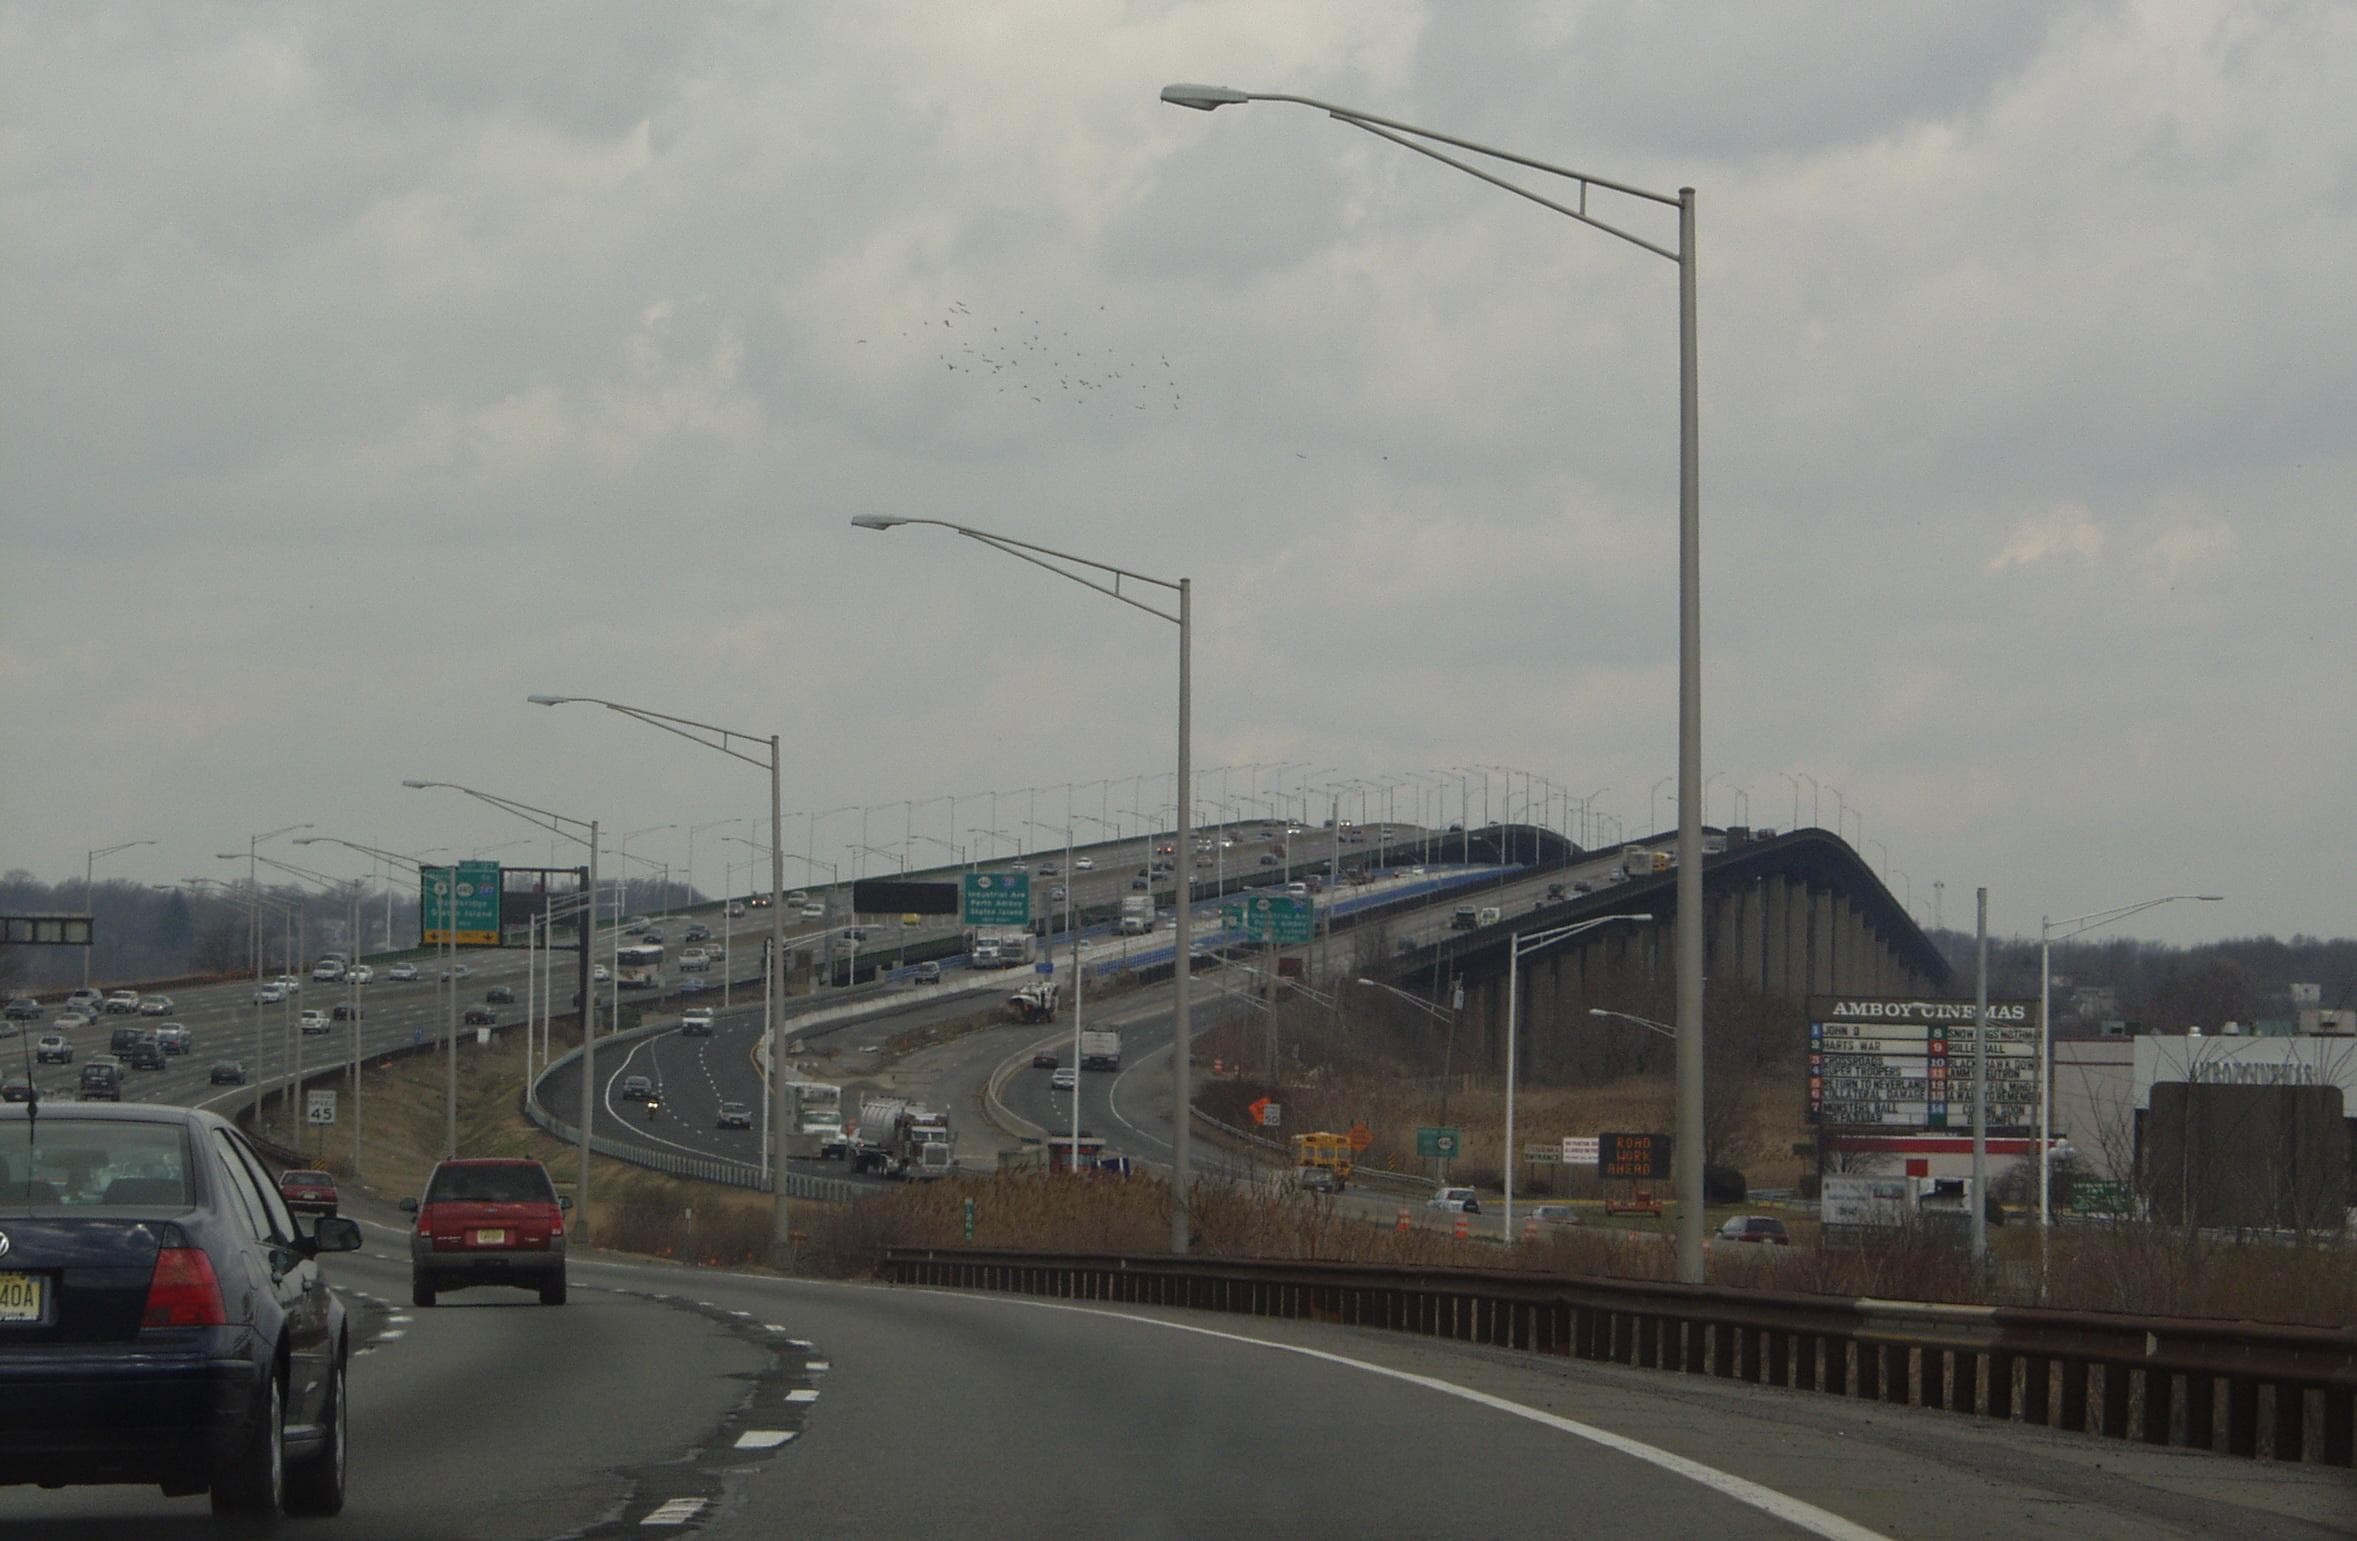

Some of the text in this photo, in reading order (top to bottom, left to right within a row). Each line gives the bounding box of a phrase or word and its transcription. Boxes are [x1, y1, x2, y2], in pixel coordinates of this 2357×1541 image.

[1832, 1002, 2026, 1020] AMBOY CINEMAS
[1824, 1026, 1848, 1036] JOHN
[1933, 1028, 1942, 1038] 8
[1949, 1029, 1974, 1039] SNOW
[1811, 1040, 1820, 1049] 2
[1824, 1040, 1881, 1052] HARTS WAR
[1933, 1042, 1943, 1053] 9
[1931, 1059, 1945, 1068] 10
[1812, 1065, 1820, 1074] 4
[1857, 1080, 1872, 1089] TO
[1812, 1102, 1820, 1111] 7
[1875, 1103, 1899, 1113] BALL
[311, 1107, 332, 1120] 45
[1616, 1137, 1650, 1148] ROAD
[1616, 1151, 1650, 1162] WORK
[1608, 1163, 1650, 1175] AHEAD
